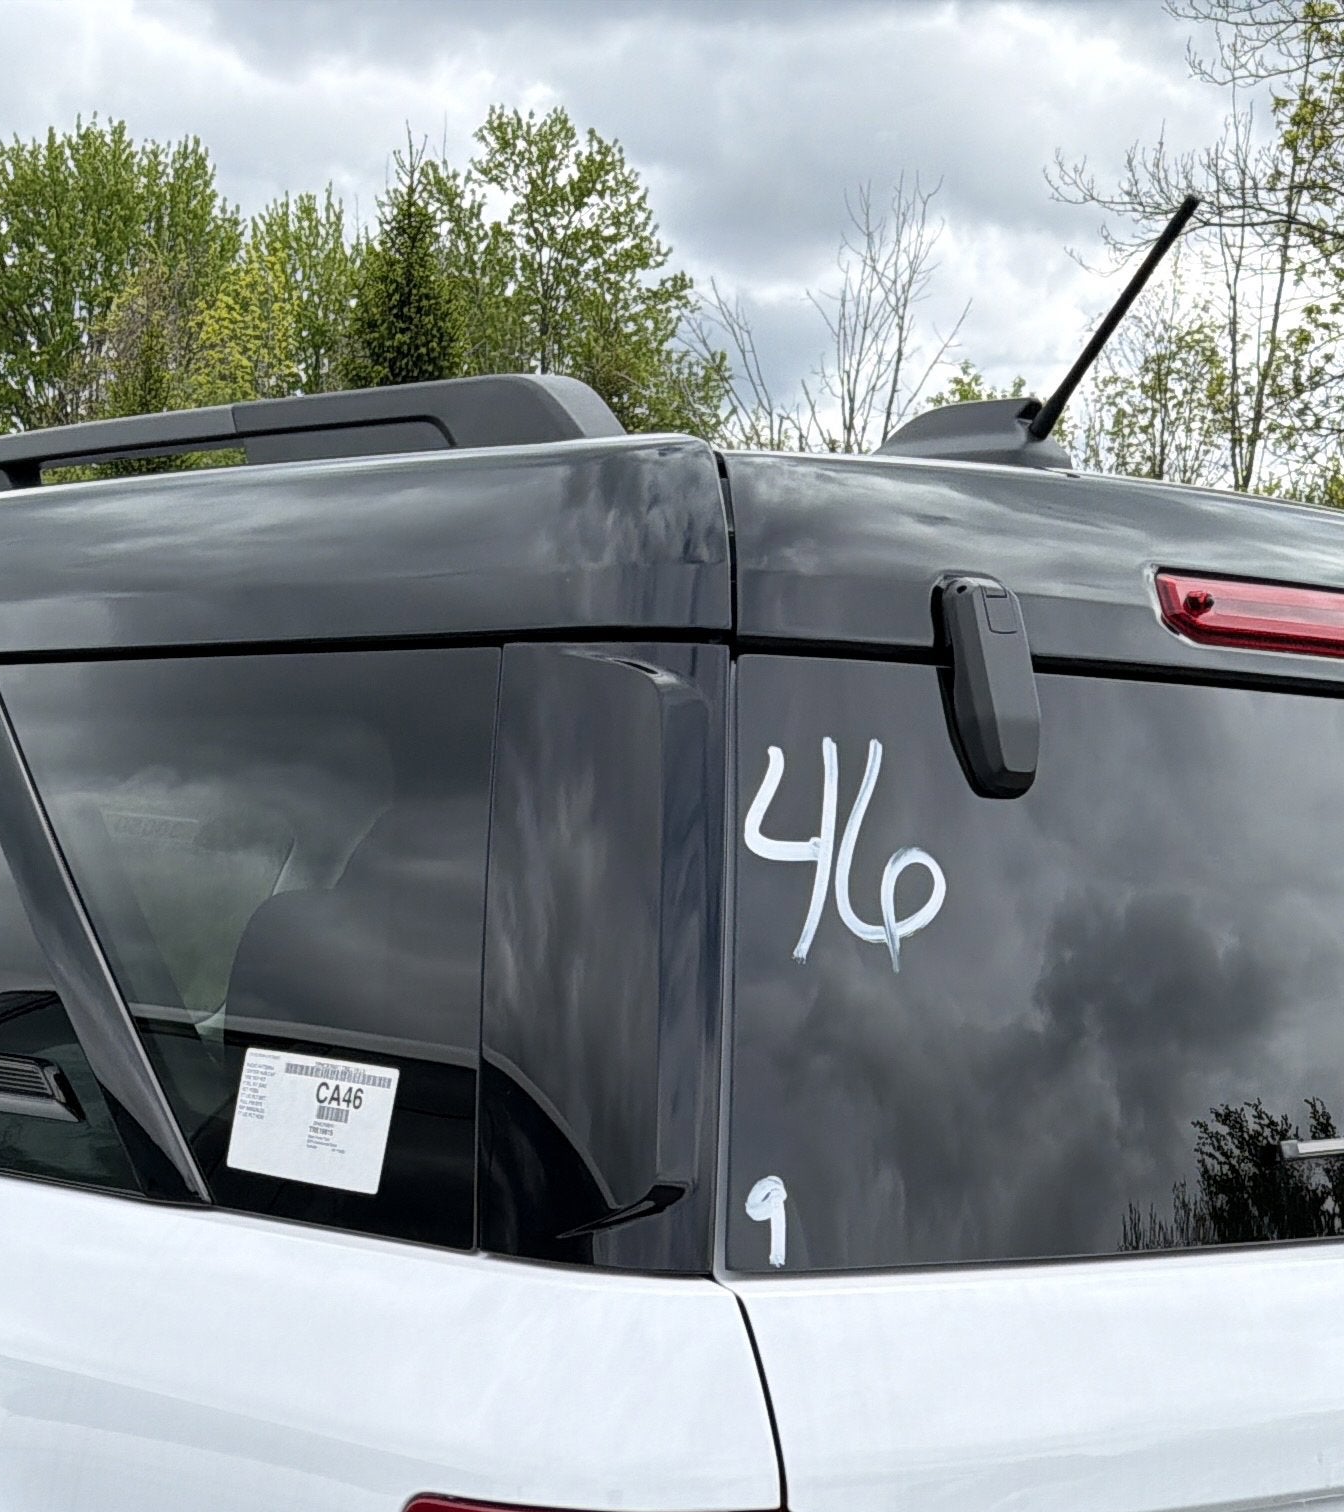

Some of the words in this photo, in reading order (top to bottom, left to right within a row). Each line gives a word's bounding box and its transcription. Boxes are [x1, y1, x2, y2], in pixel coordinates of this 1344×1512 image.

[744, 736, 946, 974] 46
[315, 1081, 364, 1110] CA46
[744, 1175, 787, 1268] 9
